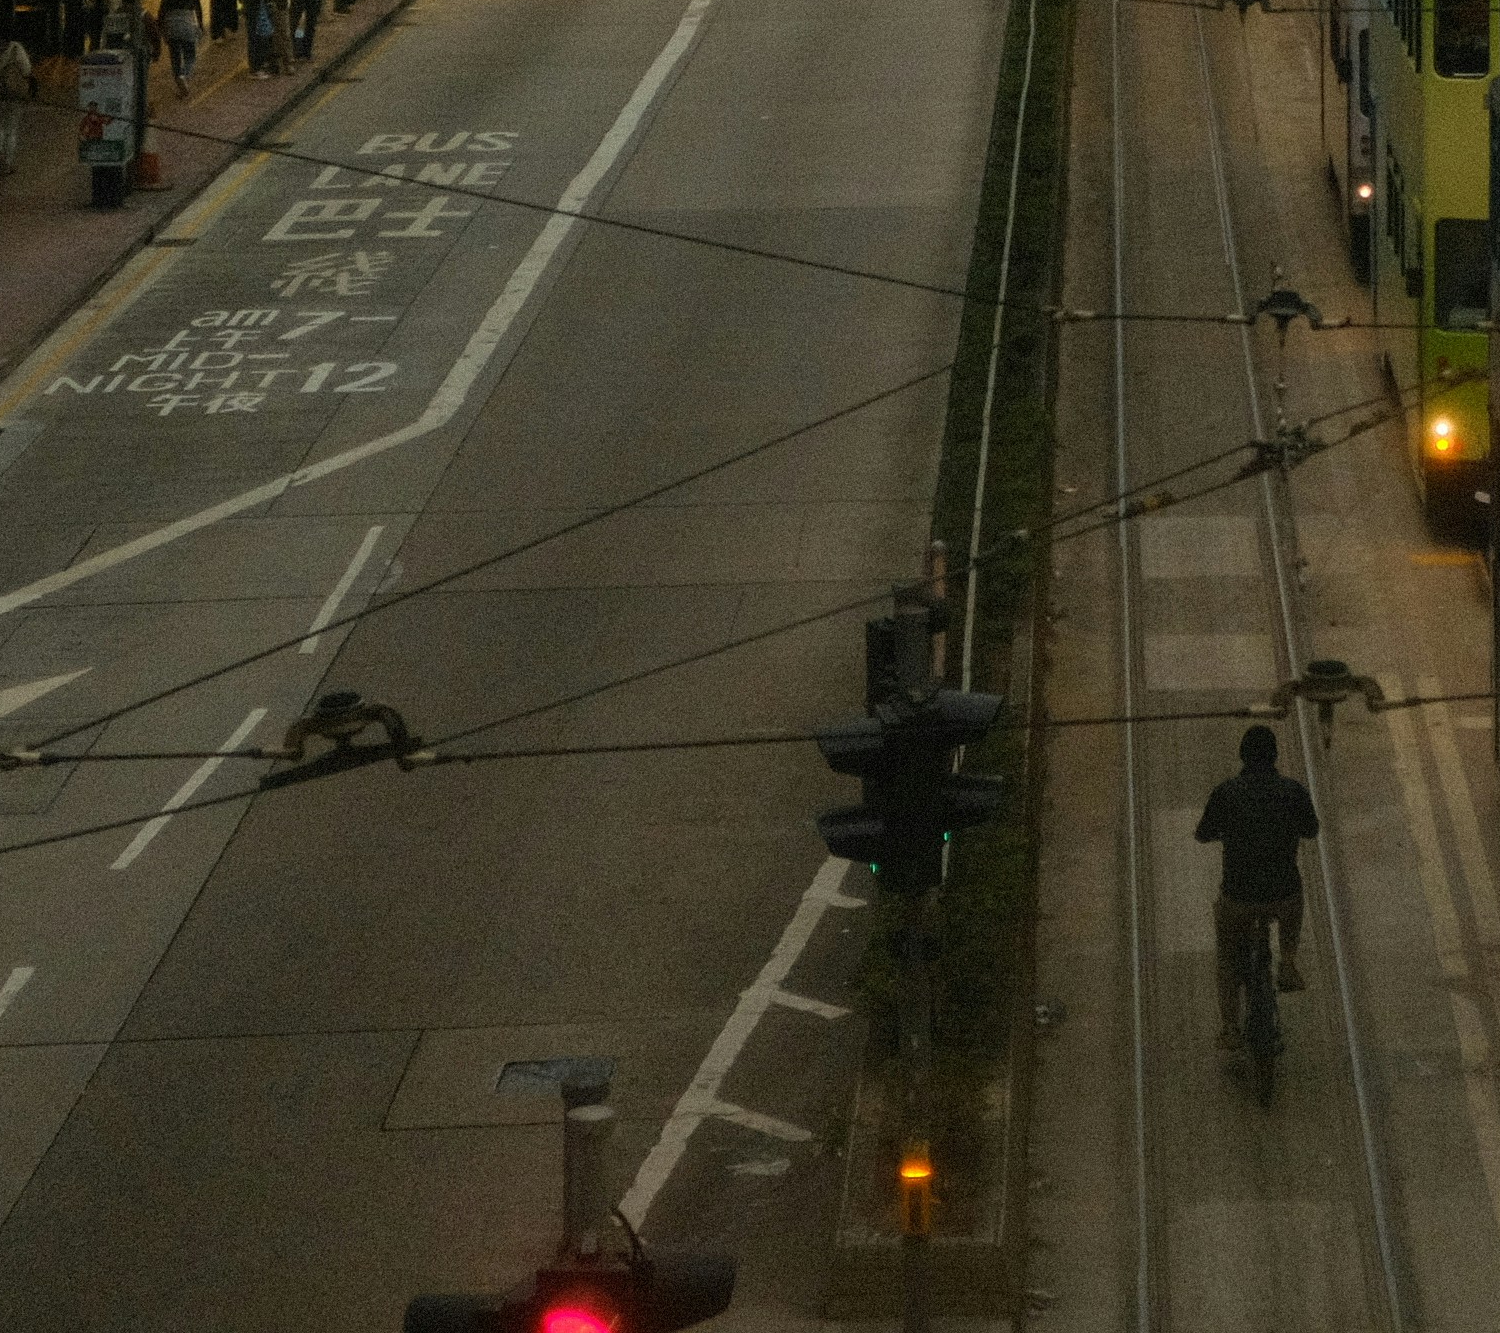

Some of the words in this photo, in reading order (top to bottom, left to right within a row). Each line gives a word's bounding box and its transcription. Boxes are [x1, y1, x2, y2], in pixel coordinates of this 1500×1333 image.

[357, 132, 519, 155] BUS
[309, 161, 513, 190] LANE
[262, 196, 472, 242] 巴士
[190, 309, 280, 328] am
[144, 329, 268, 353] 上午
[44, 369, 298, 395] NIGHT
[299, 361, 399, 394] 12
[145, 392, 268, 418] 午夜
